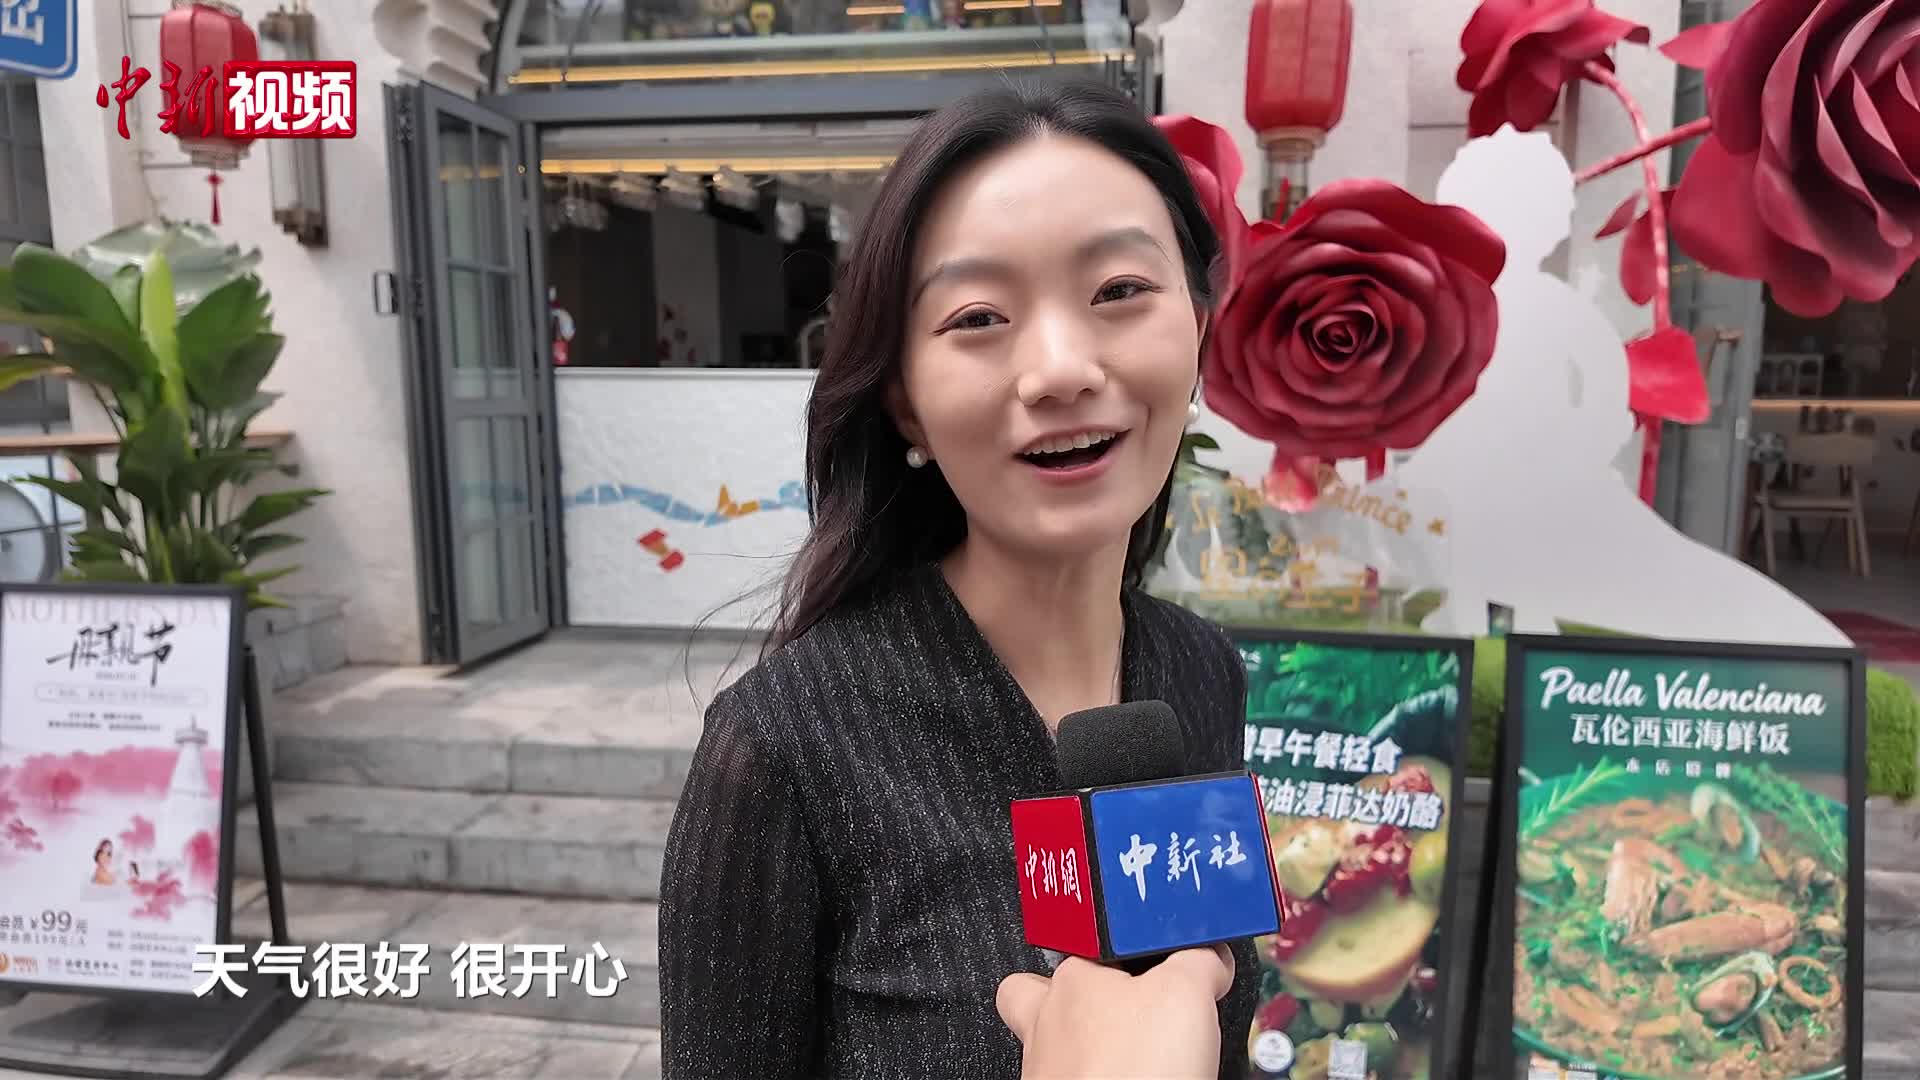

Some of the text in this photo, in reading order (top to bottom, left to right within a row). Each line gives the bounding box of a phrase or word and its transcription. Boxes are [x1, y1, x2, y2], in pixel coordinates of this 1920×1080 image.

[1540, 667, 1827, 716] Paella Valenciana
[1571, 714, 1790, 755] 瓦伦西亚海鲜饭
[1119, 831, 1247, 901] 中新社
